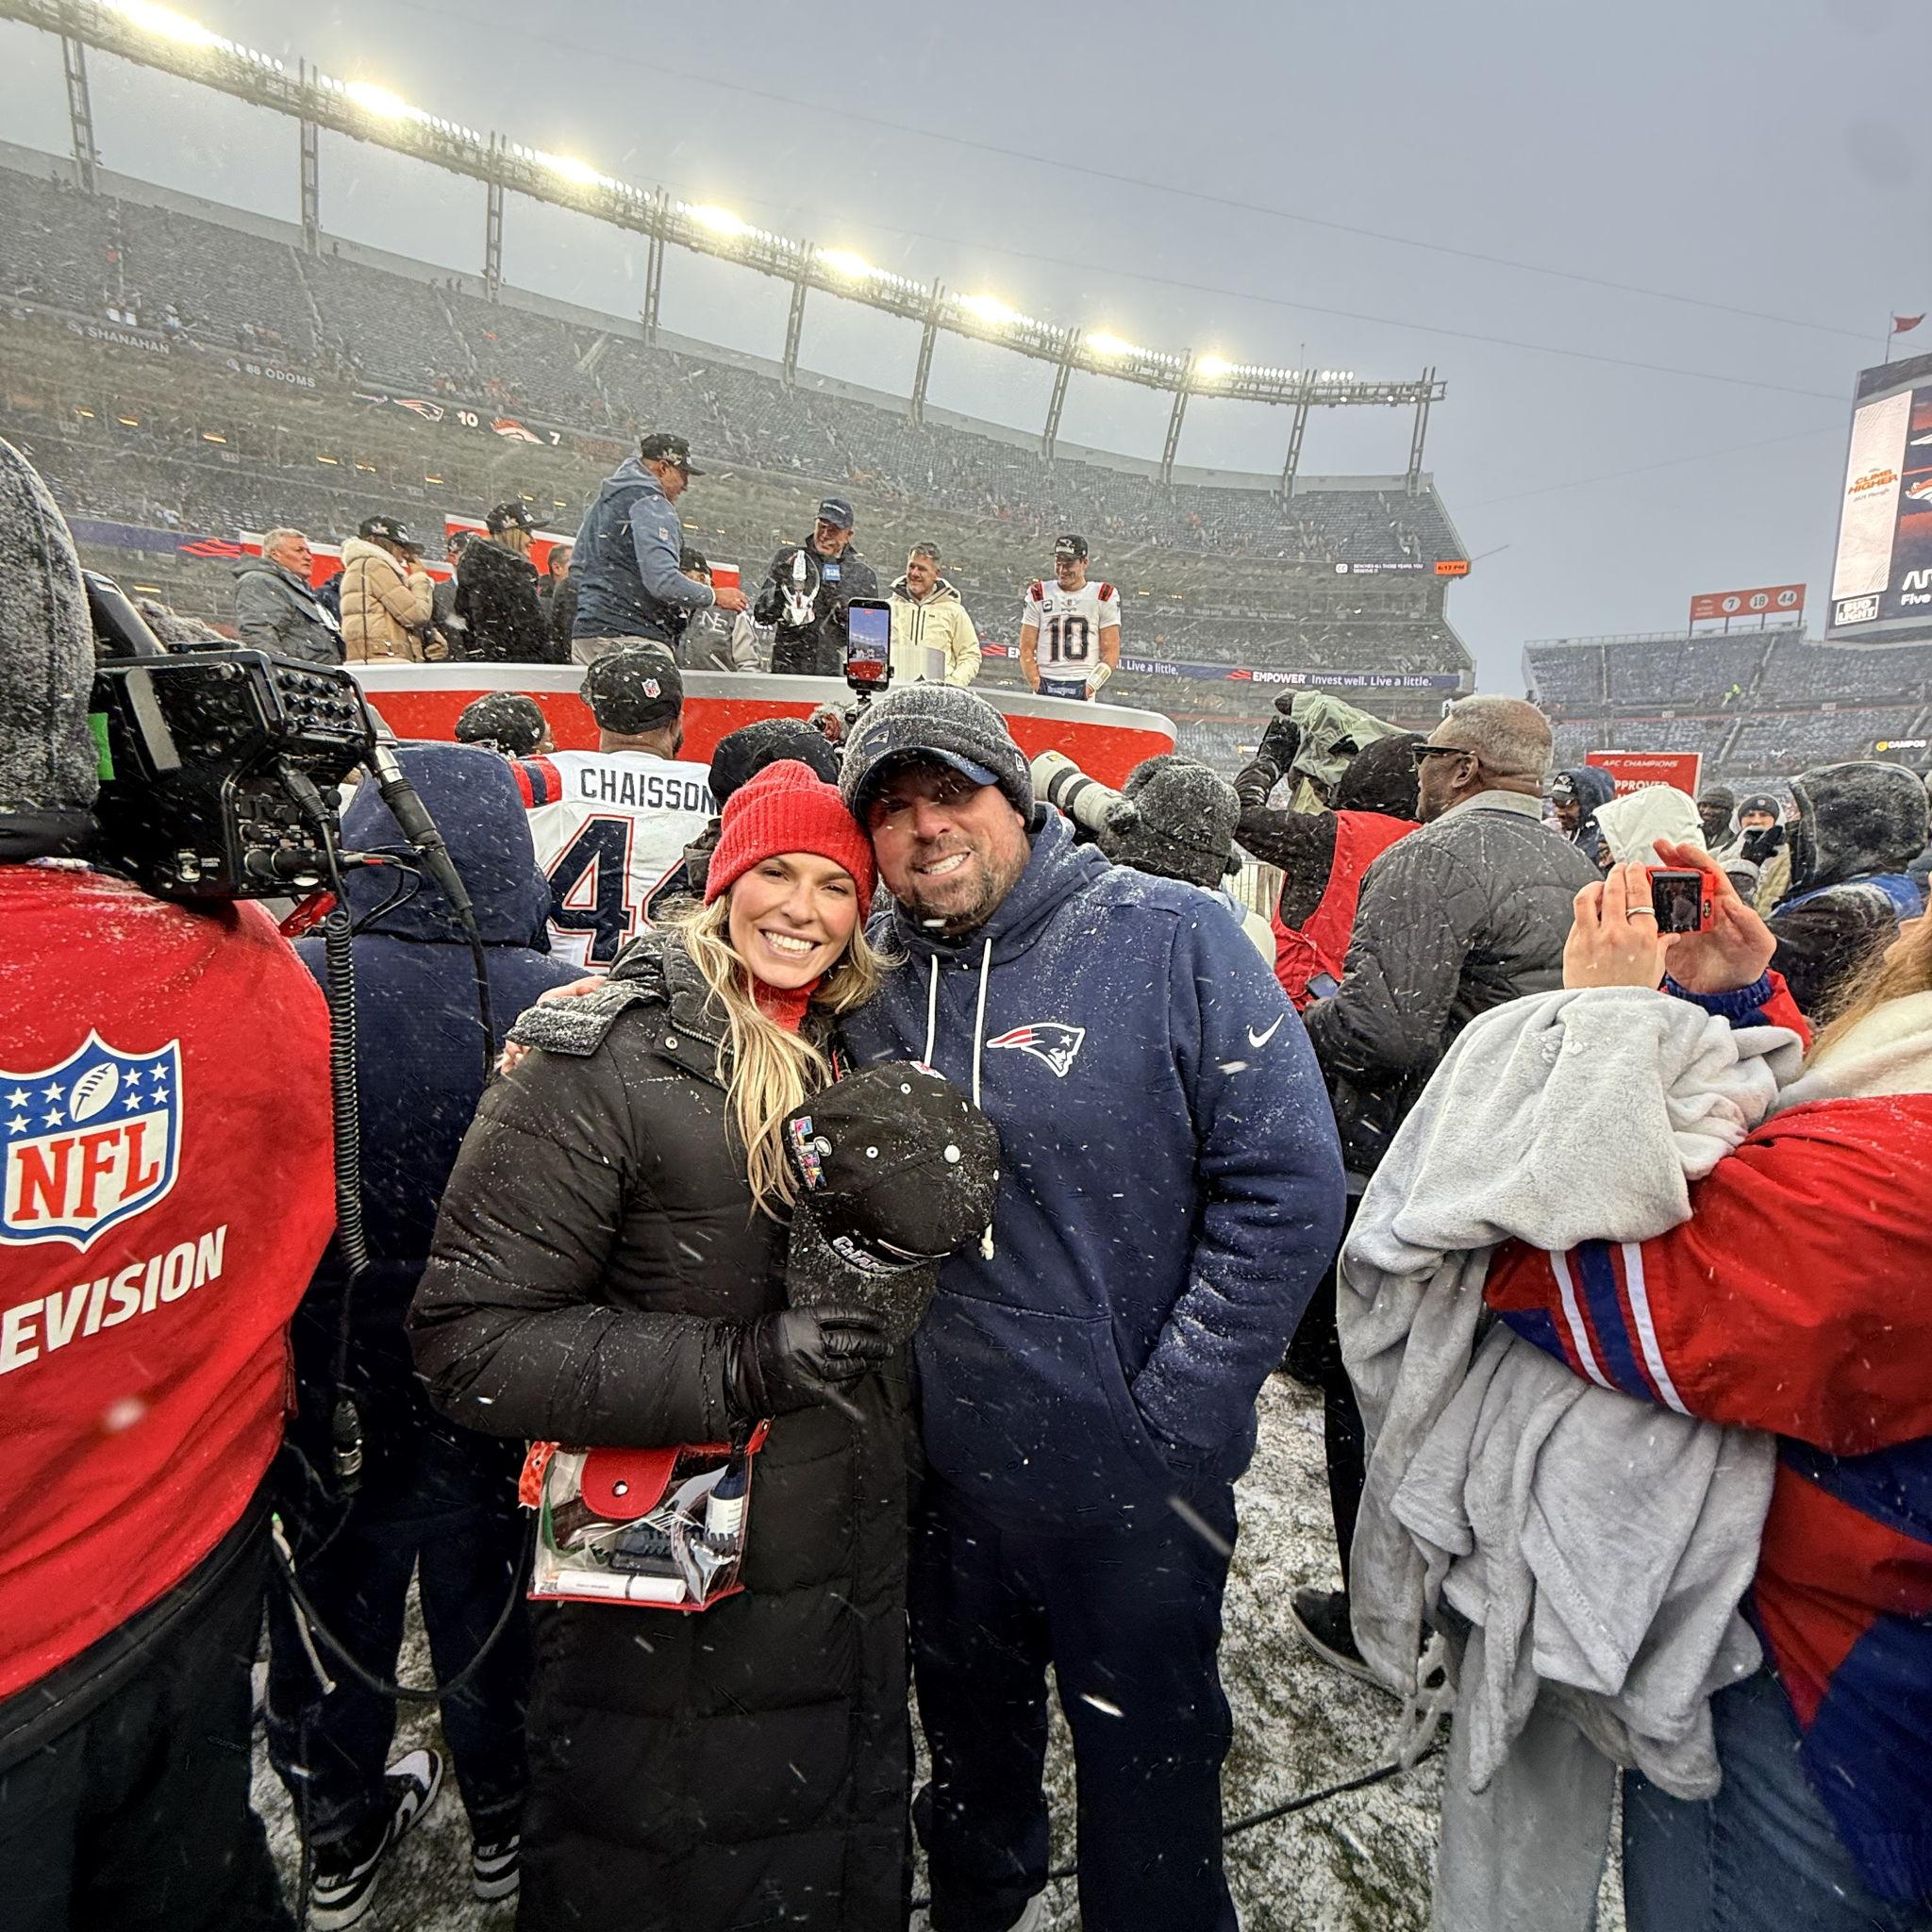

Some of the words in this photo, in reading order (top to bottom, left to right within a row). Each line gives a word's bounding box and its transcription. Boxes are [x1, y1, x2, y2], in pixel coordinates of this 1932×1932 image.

[88, 326, 171, 355] SHANAHAN
[264, 368, 317, 389] ODOMS
[457, 410, 479, 427] 10
[549, 431, 561, 445] 7
[1847, 475, 1898, 495] HIGHER
[1727, 598, 1736, 609] 7
[1753, 595, 1766, 608] 18
[1780, 592, 1794, 604] 44
[1842, 599, 1873, 612] BUD
[1901, 593, 1931, 606] Five
[1839, 607, 1875, 623] LIGHT
[1047, 615, 1090, 662] 10
[1126, 660, 1146, 672] Live
[1147, 664, 1153, 673] a
[1155, 662, 1179, 675] little.
[1253, 671, 1305, 684] EMPOWER
[1311, 675, 1342, 685] Invest
[1343, 675, 1368, 686] well.
[1371, 675, 1391, 686] Live
[1404, 675, 1432, 687] little.
[1624, 759, 1678, 768] CHAMPIONS
[580, 768, 720, 815] CHAISSON
[11, 1122, 160, 1222] NFL
